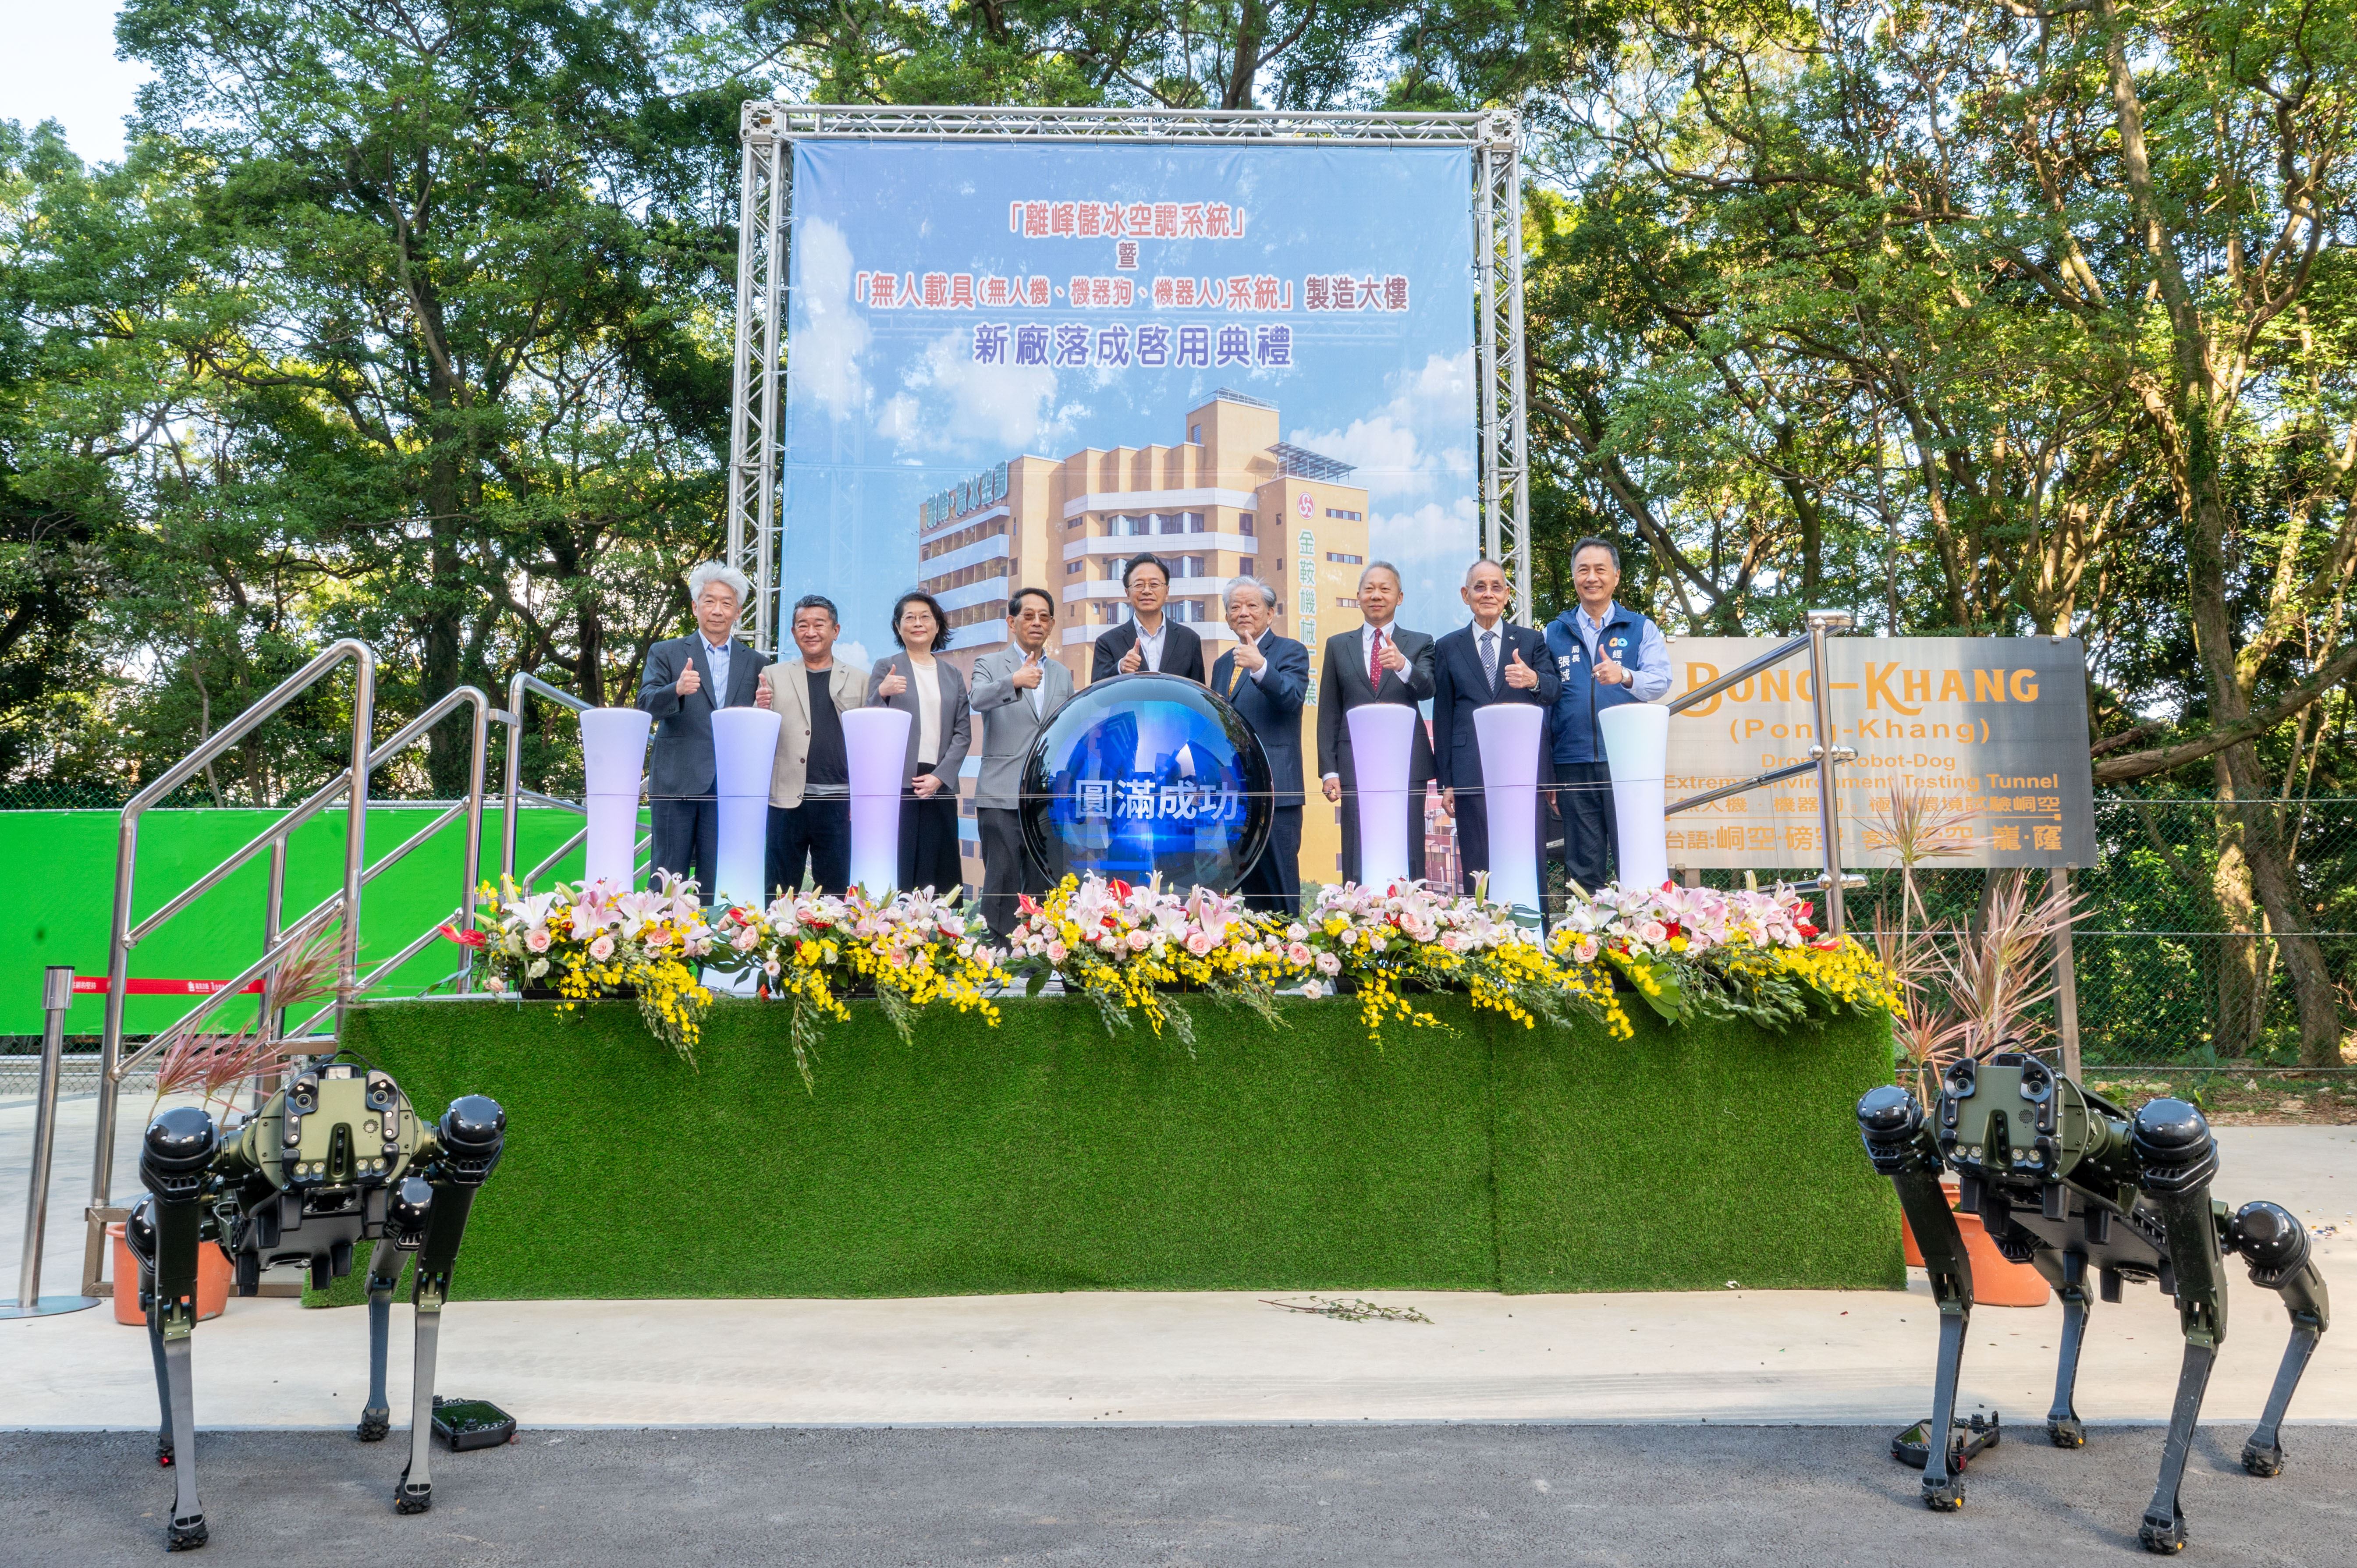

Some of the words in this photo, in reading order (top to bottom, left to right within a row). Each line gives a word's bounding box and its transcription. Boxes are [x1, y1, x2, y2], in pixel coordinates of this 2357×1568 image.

[1012, 202, 1243, 237] 「離峰儲冰空調系統」
[1118, 241, 1137, 268] 暨
[1572, 645, 1580, 663] 局長
[1761, 753, 1811, 768] Dron
[1902, 774, 1980, 792] Testing
[1986, 773, 2059, 789] Tunnel
[1075, 779, 1239, 820] 圓滿成功
